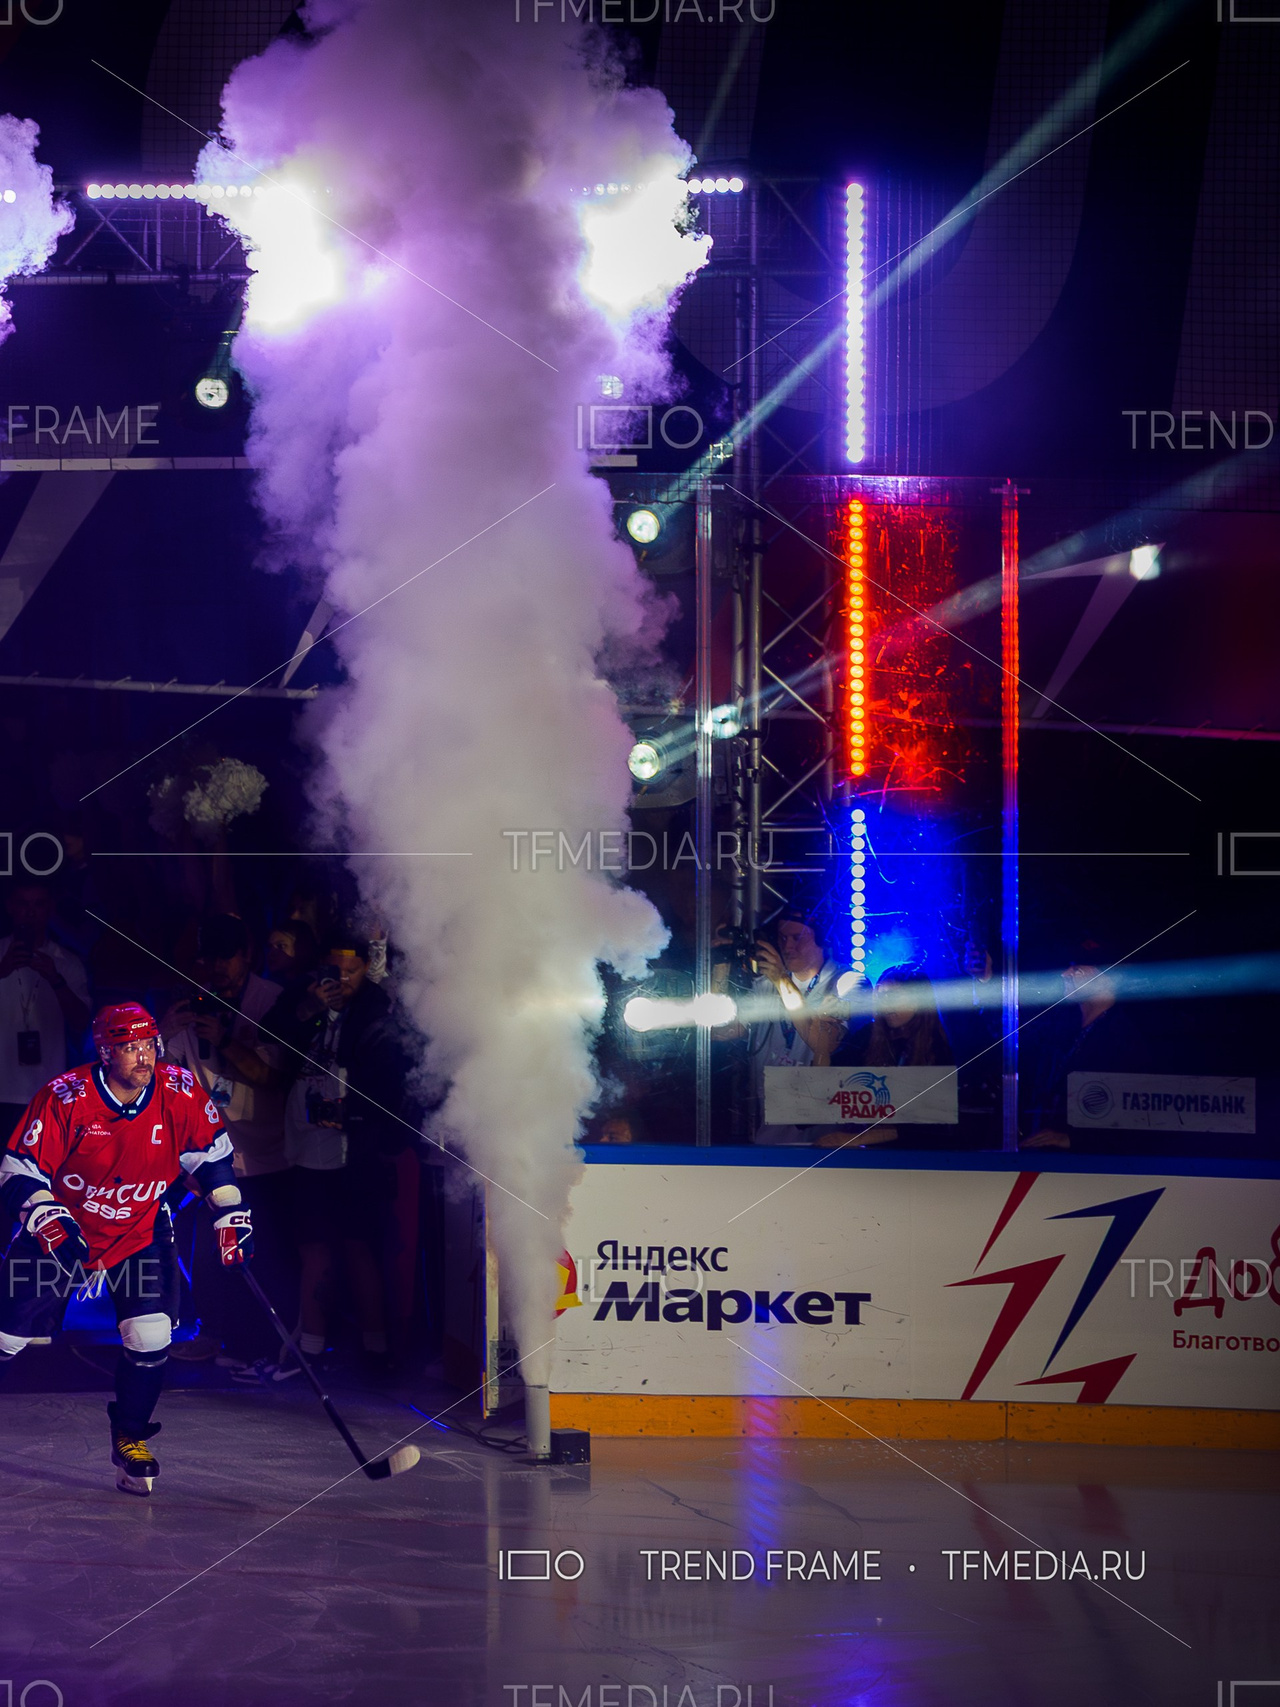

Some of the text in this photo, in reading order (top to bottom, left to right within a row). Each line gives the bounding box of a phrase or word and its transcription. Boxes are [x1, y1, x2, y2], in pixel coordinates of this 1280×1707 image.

[828, 1091, 872, 1105] АВТО
[1122, 1092, 1246, 1114] ГАЗПРОМБАНК
[841, 1104, 896, 1118] РАДИО
[23, 1118, 43, 1146] 8
[151, 1124, 163, 1144] C
[597, 1239, 729, 1276] Яндекс
[593, 1281, 872, 1331] Маркет
